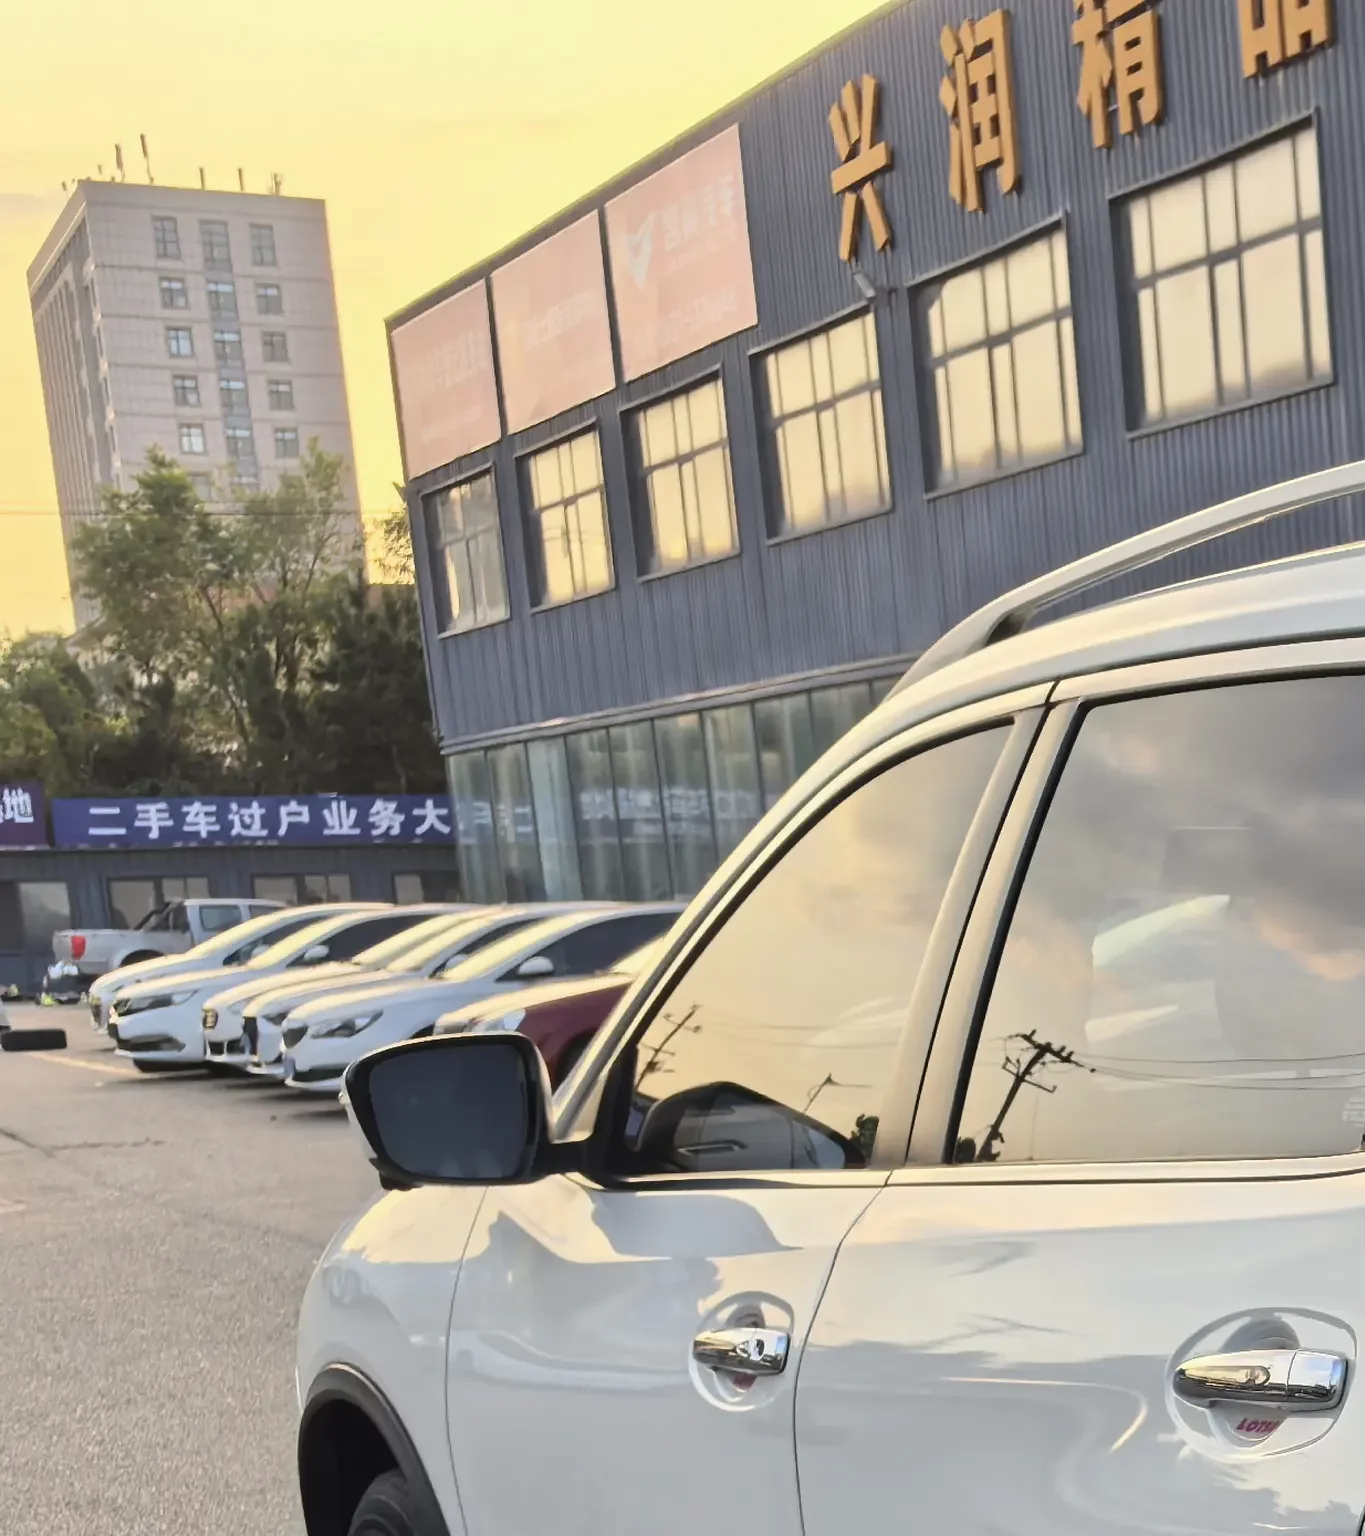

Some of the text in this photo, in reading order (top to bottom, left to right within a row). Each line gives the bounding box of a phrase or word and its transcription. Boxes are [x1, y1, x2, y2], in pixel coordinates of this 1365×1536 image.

[0, 787, 35, 824] 地
[88, 797, 452, 839] 二手车过户业务大
